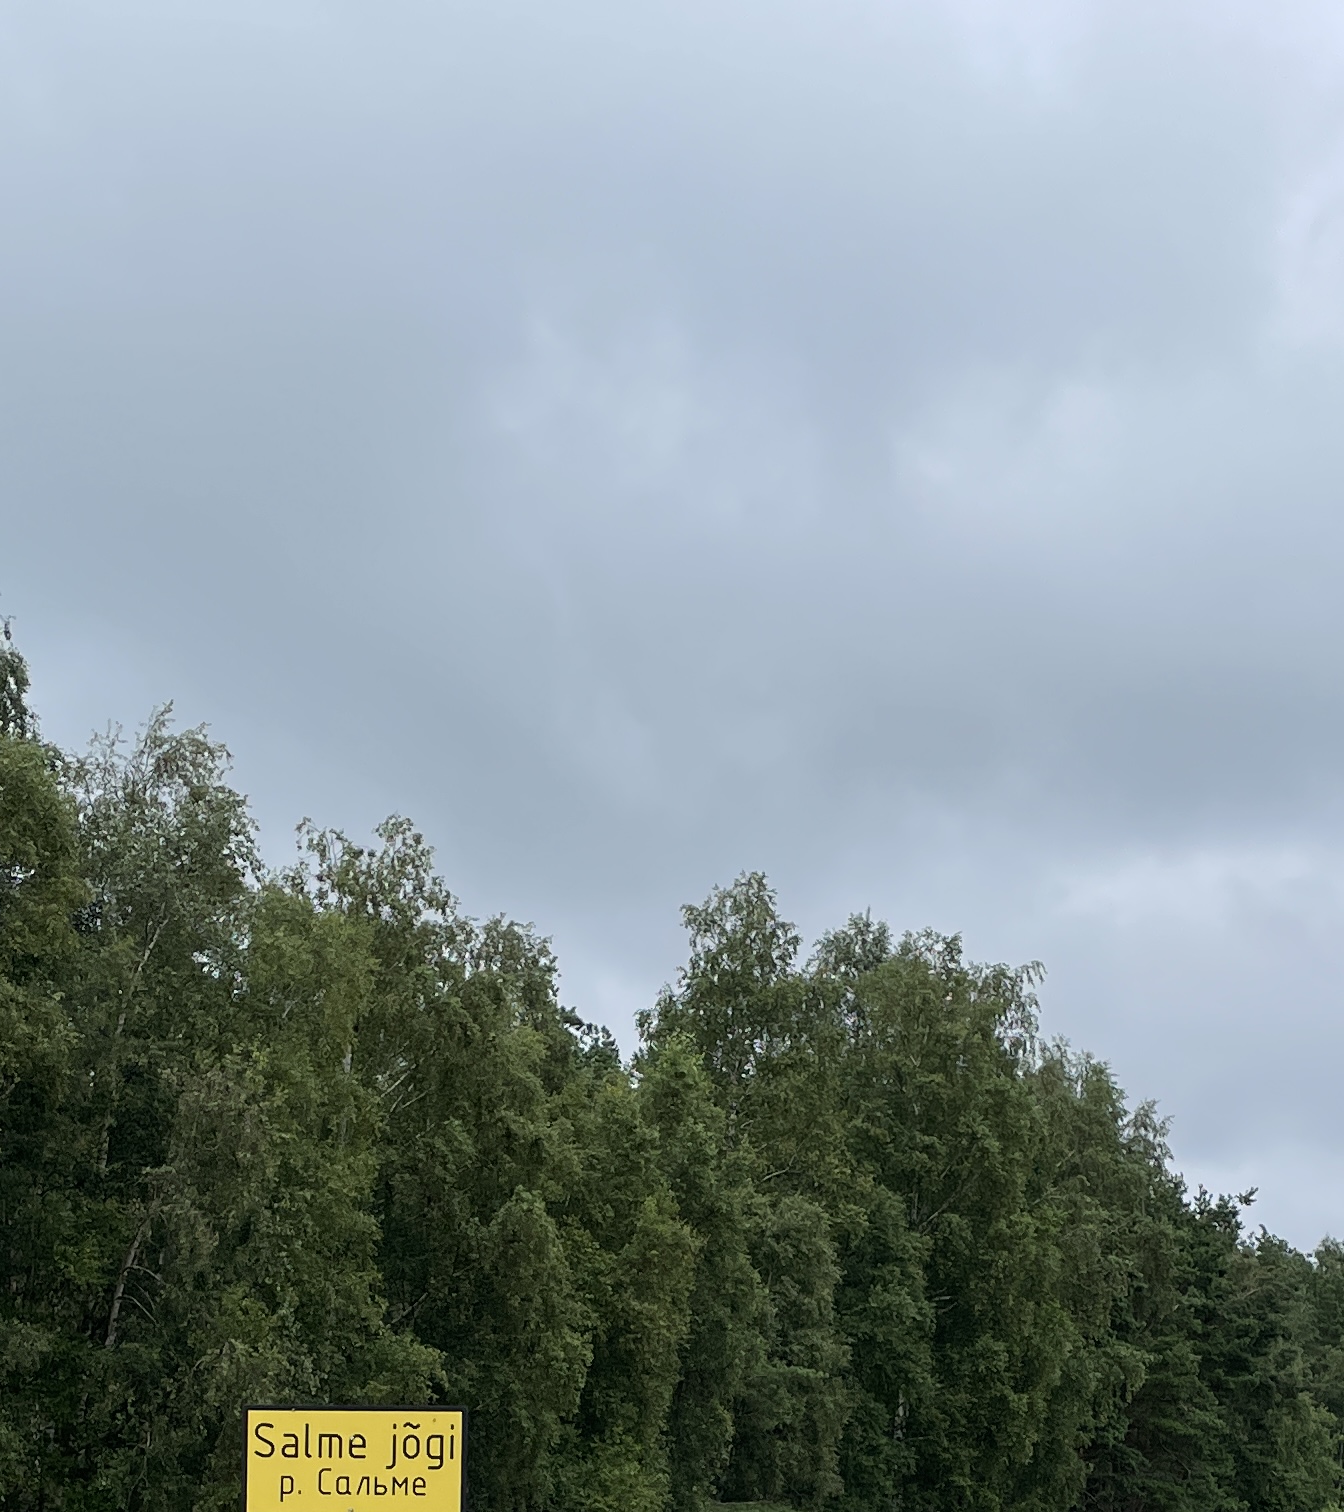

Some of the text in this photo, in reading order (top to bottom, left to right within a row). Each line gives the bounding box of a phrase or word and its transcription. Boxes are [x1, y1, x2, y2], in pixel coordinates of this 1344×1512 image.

[253, 1421, 455, 1470] Salme jõgi
[279, 1467, 427, 1503] р. Сальме
